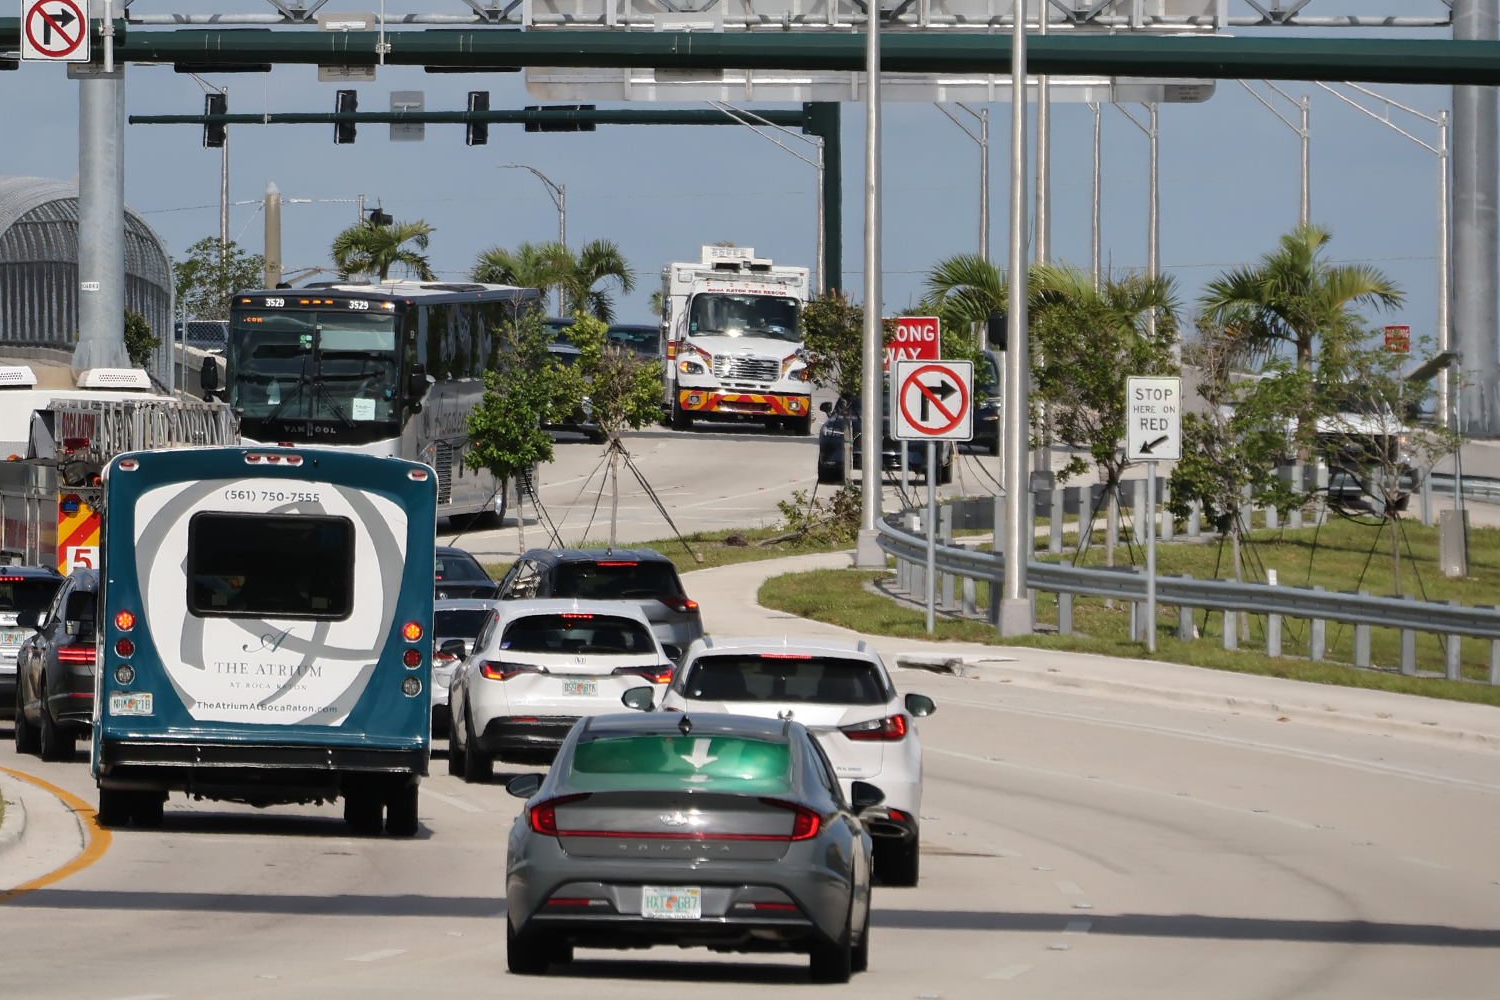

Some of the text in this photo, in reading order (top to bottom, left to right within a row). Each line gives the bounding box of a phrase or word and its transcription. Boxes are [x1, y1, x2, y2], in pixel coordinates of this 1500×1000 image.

[265, 298, 285, 307] 3529
[349, 301, 369, 310] 3529
[893, 325, 935, 342] ONG
[1135, 388, 1173, 401] STOP
[1133, 405, 1176, 414] HERE ON
[1140, 418, 1169, 431] RED
[224, 490, 320, 503] (561) 750-7555
[73, 549, 92, 569] 5
[214, 661, 322, 678] THE ATRIUM
[276, 683, 308, 691] RATON
[196, 701, 338, 713] TheAtriumAtBocaRaton.com
